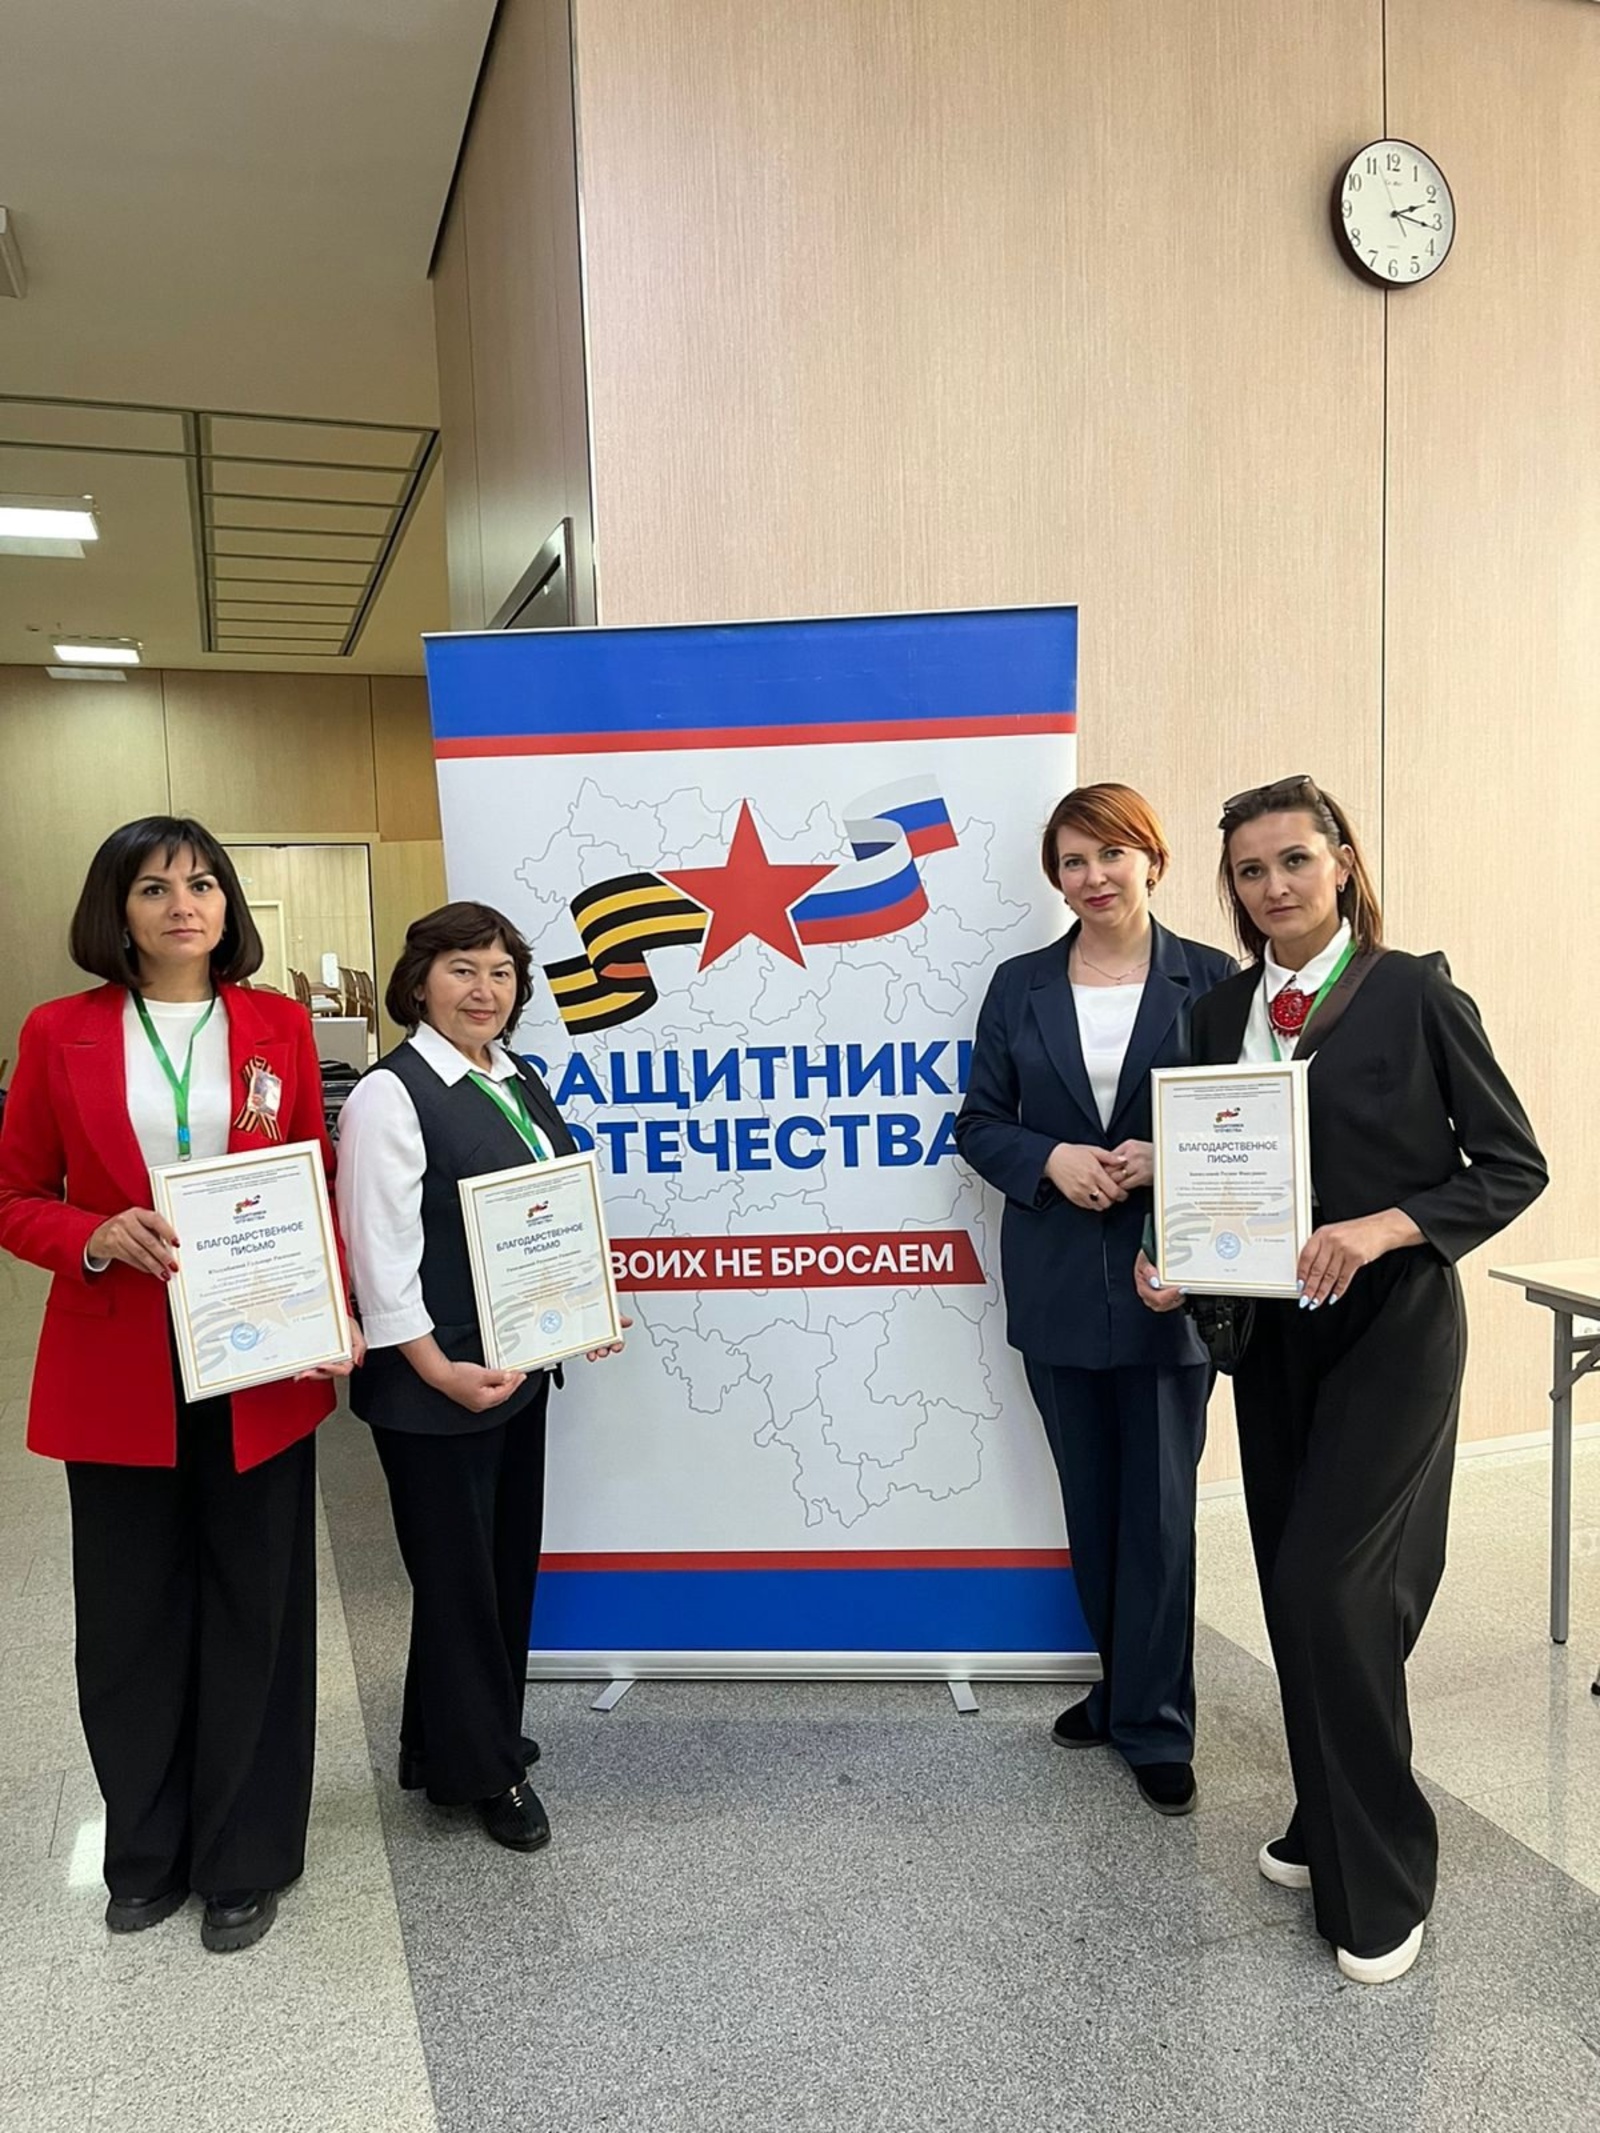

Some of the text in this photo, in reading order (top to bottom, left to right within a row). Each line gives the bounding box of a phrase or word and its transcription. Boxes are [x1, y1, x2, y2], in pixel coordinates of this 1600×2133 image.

[1366, 156, 1377, 175] 11
[1386, 153, 1401, 172] 12
[1348, 173, 1362, 192] 10
[1413, 165, 1418, 182] 1
[1426, 184, 1437, 203] 2
[1342, 199, 1353, 218] 9
[1432, 213, 1442, 231] 3
[1350, 227, 1361, 247] 8
[1425, 237, 1434, 256] 4
[1368, 249, 1379, 267] 7
[1410, 255, 1420, 274] 5
[1388, 259, 1399, 278] 6
[520, 1040, 973, 1109] АЩИТНИК
[1178, 1140, 1278, 1152] БЛАГОДАРСТВЕННОЕ
[1207, 1154, 1249, 1163] ПИСЬМО
[196, 1221, 304, 1251] БЛАГОДАРСТВЕННОЕ
[496, 1222, 584, 1252] БЛАГОДАРСТВЕННОЕ
[230, 1239, 276, 1257] ПИСЬМО
[524, 1239, 561, 1255] ПИСЬМО
[611, 1249, 708, 1280] ВОИХ
[715, 1247, 763, 1277] НЕ
[771, 1243, 954, 1276] БРОСАЕМ
